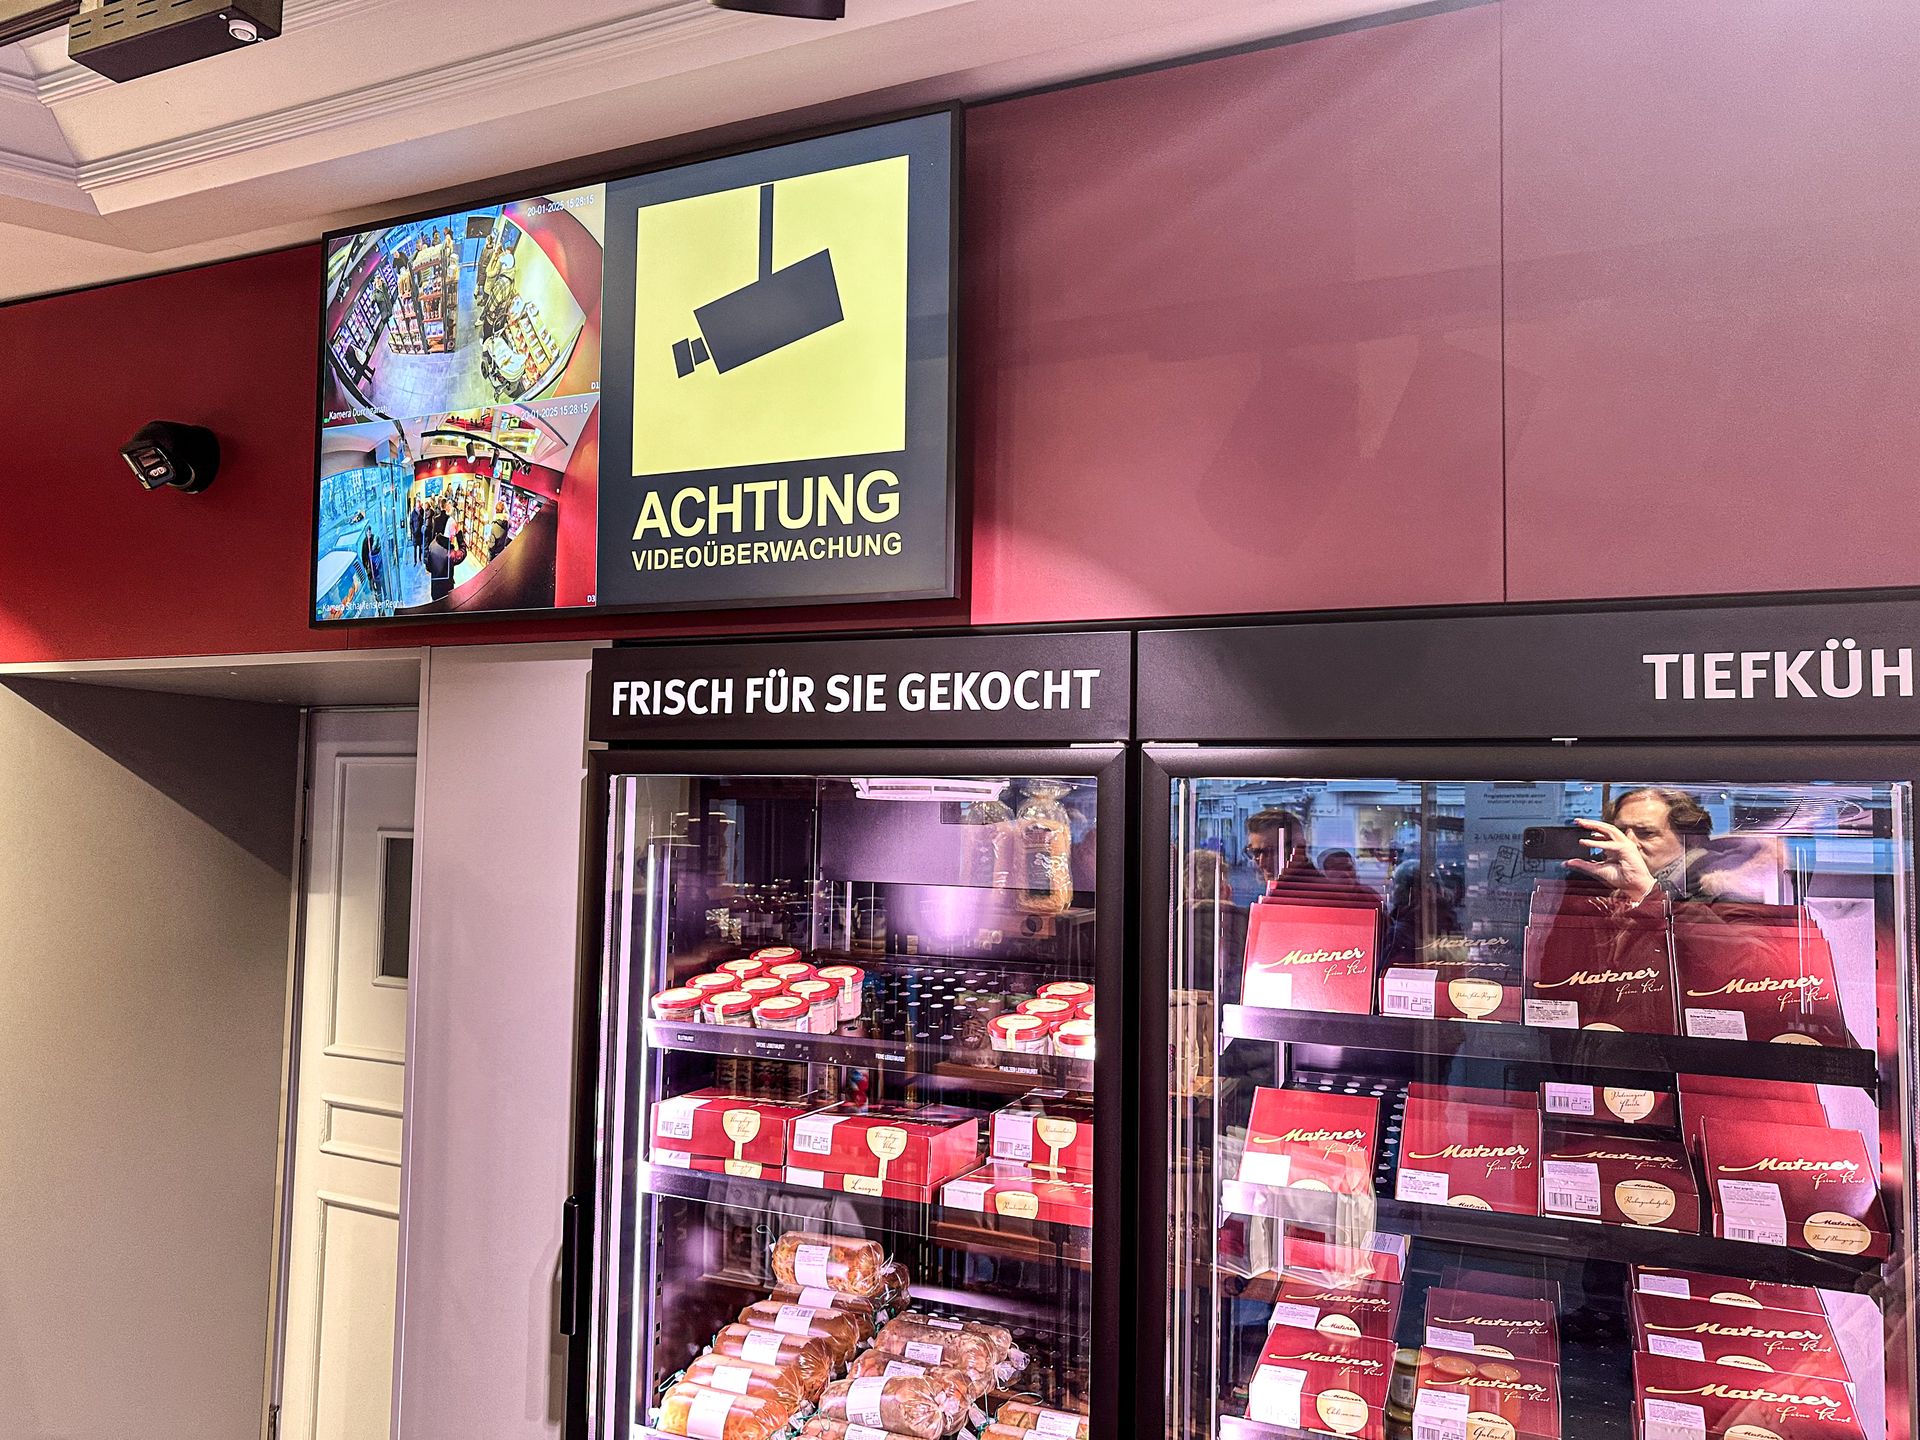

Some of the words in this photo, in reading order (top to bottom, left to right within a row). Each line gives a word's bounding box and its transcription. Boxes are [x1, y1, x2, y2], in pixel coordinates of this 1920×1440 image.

[527, 202, 564, 217] 20-01-2025
[566, 194, 594, 208] 15:28:15
[328, 409, 351, 420] Kamera
[521, 407, 558, 421] 20-01-2025
[560, 402, 588, 415] 15:28:15
[631, 469, 900, 541] ACHTUNG
[631, 531, 902, 571] VIDEOÜBERWACHUNG
[587, 594, 596, 603] D3
[322, 603, 344, 612] Kamera
[1642, 637, 1913, 700] TIEFKÜH
[611, 677, 734, 716] FRISCH
[745, 668, 815, 714] FÜR
[824, 674, 887, 713] SIE
[897, 669, 1101, 712] GEKOCHT
[1251, 947, 1366, 969] Matzner
[1533, 967, 1659, 988] Matzner
[1686, 975, 1824, 996] Matzner
[1253, 1128, 1366, 1144] Matzner
[1408, 1144, 1529, 1159] Matzner
[1551, 1151, 1678, 1163] Matzner
[1717, 1157, 1859, 1172] Matzner
[1285, 1292, 1391, 1305] Matzner
[1433, 1316, 1545, 1327] Matzner
[1643, 1322, 1823, 1340] Matzner
[1268, 1351, 1383, 1368] Matzner
[1425, 1376, 1547, 1392] Matzner
[1646, 1383, 1842, 1408] Matzner
[1473, 1427, 1507, 1440] Gulasch
